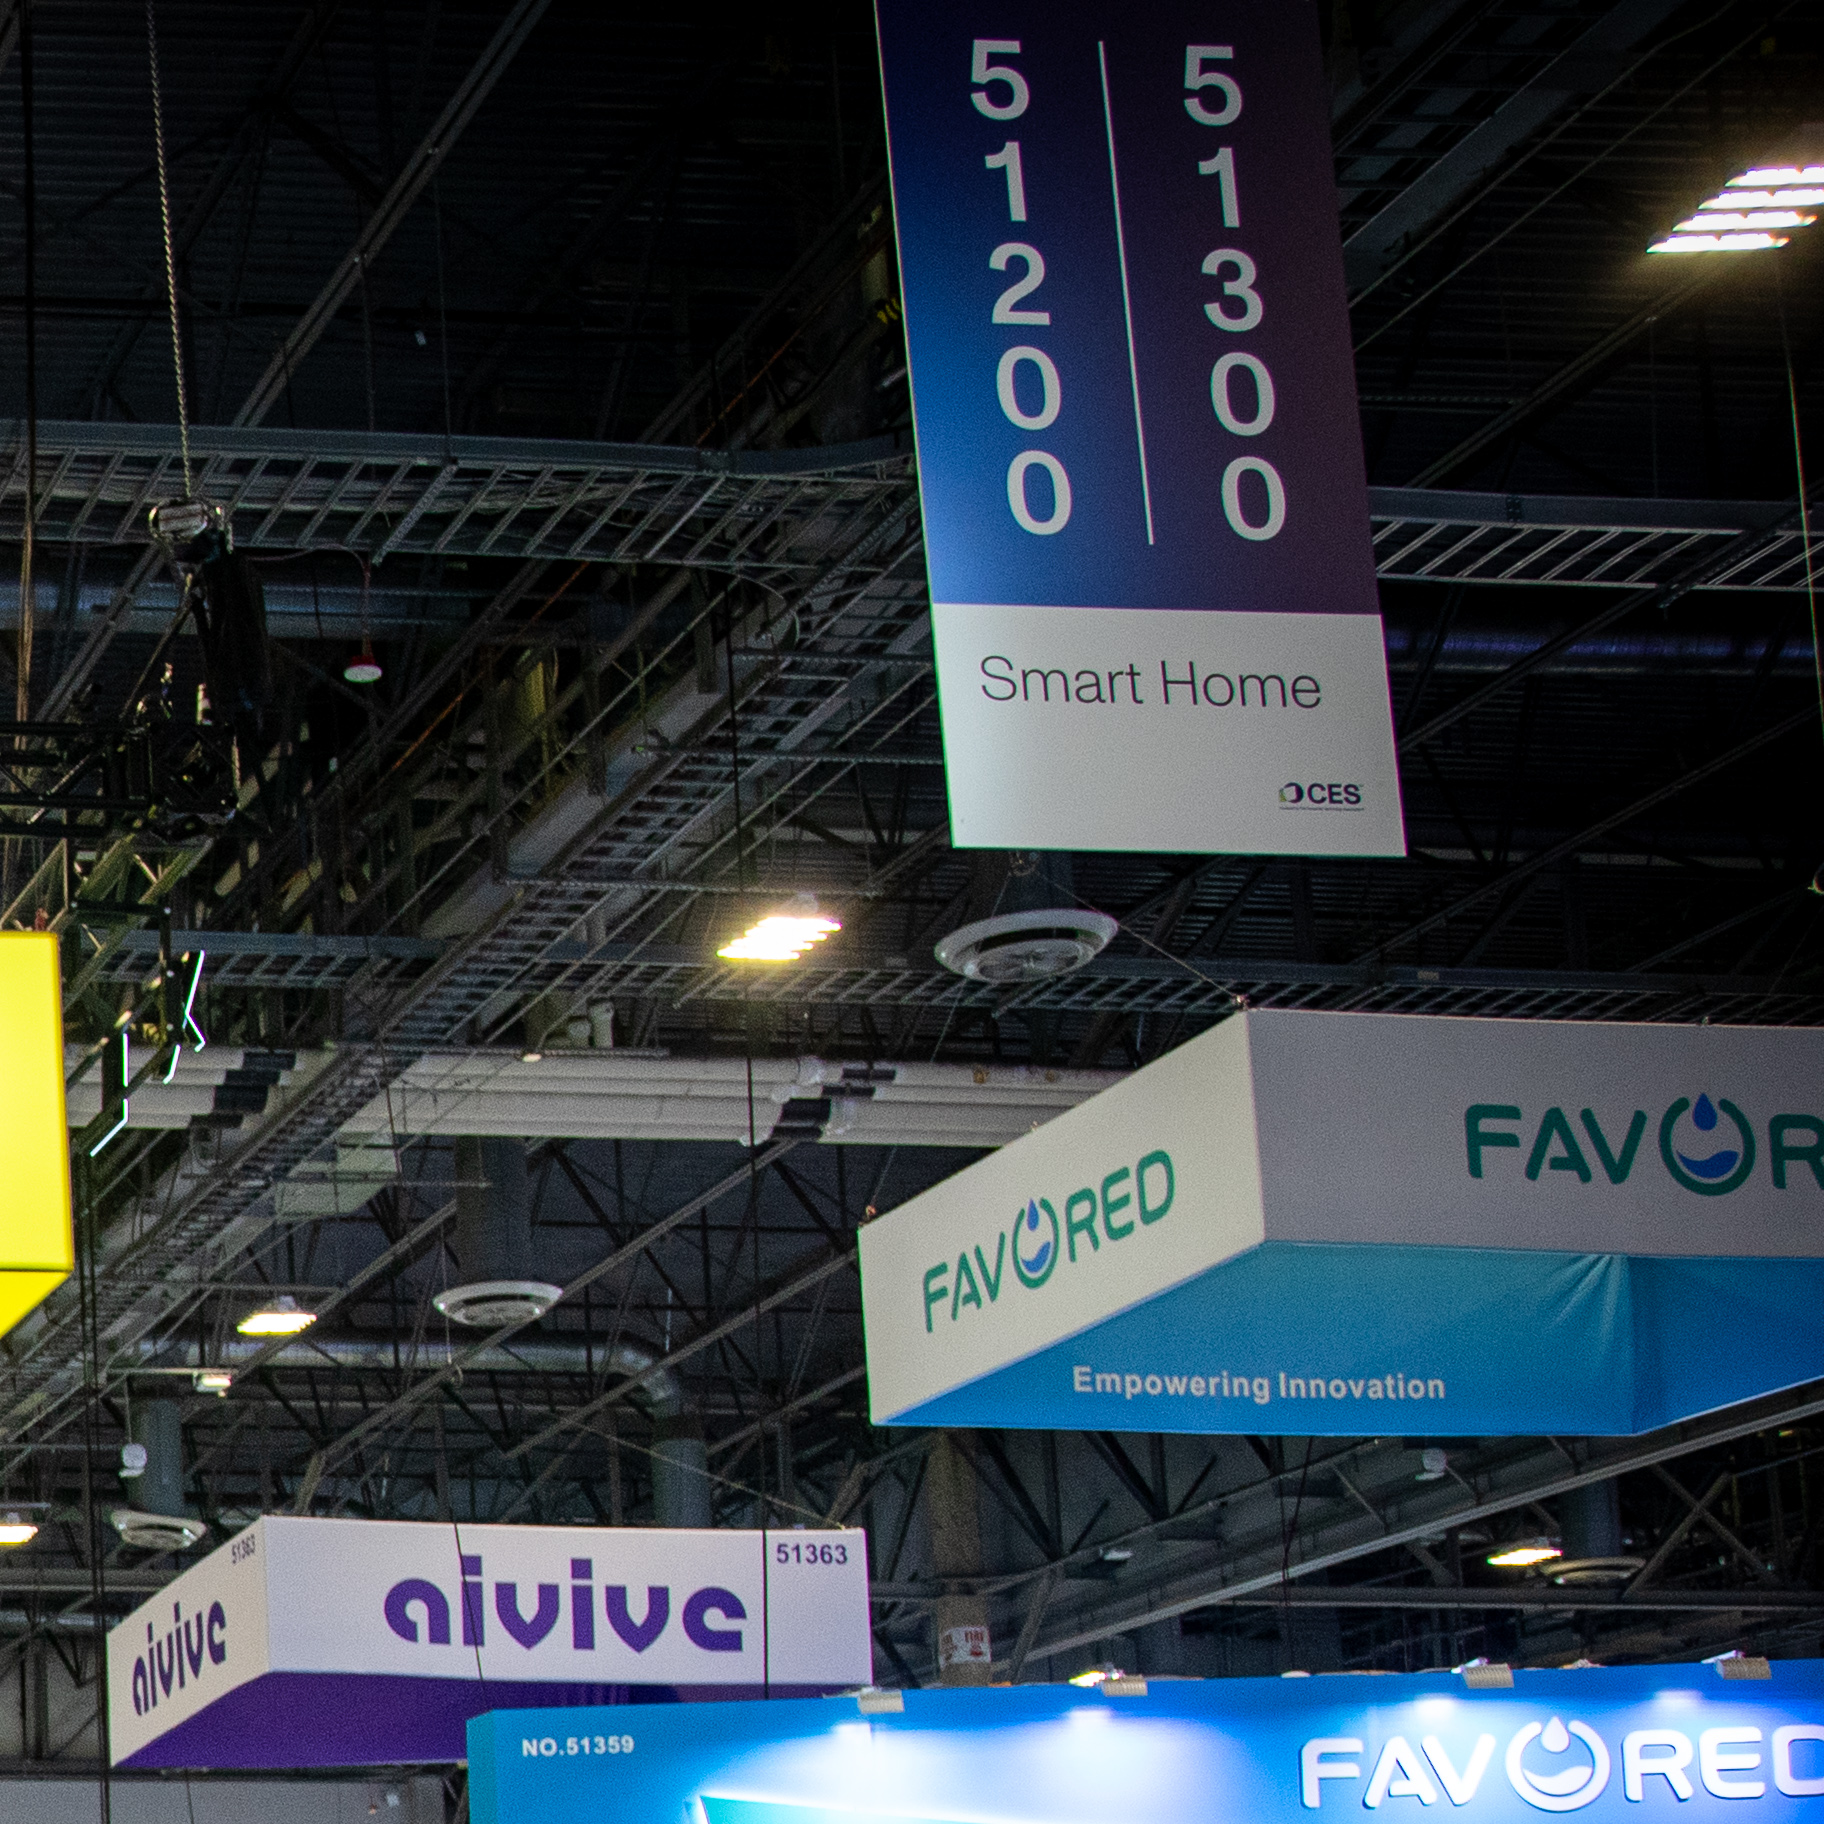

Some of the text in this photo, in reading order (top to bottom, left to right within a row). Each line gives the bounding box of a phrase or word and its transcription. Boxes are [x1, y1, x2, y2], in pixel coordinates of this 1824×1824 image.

[969, 38, 1072, 537] 51200
[1183, 44, 1286, 542] 51300
[980, 654, 1322, 710] Smart Home
[1306, 782, 1363, 806] CES
[922, 1149, 1176, 1333] FAVORED
[1072, 1364, 1446, 1405] Empowering Innovation
[775, 1542, 849, 1567] 51363
[383, 1554, 748, 1654] aivive
